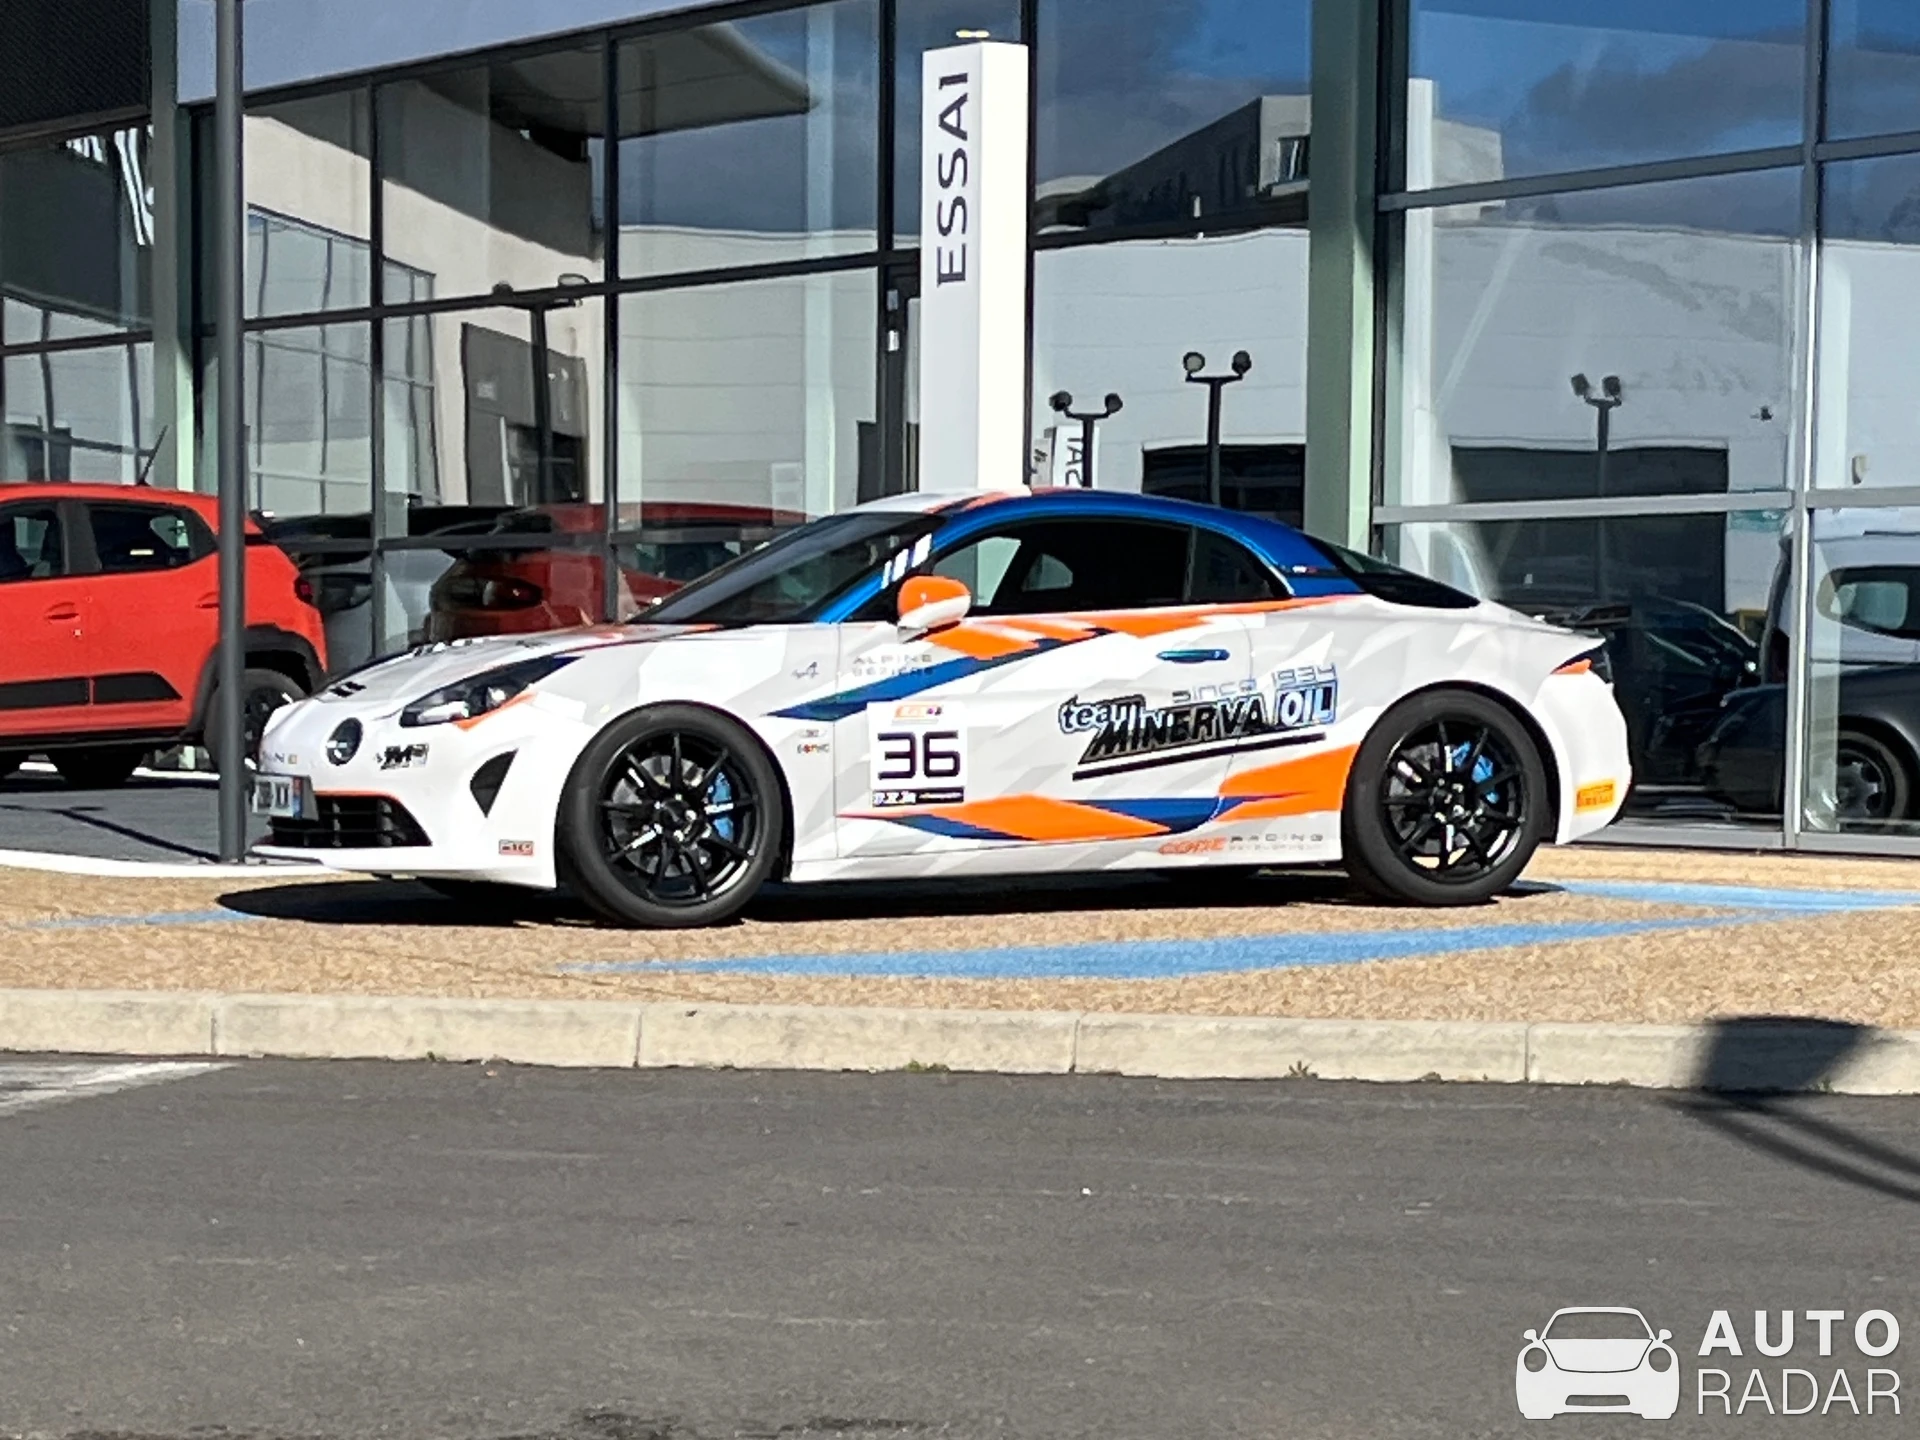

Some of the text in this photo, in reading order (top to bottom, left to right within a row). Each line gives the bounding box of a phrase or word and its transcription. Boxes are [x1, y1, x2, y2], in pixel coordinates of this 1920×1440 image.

[937, 72, 968, 287] ESSAI
[853, 653, 933, 665] ALPINE
[1271, 663, 1337, 687] 1934
[1059, 681, 1337, 764] team MINERVA OIL
[877, 730, 960, 780] 36
